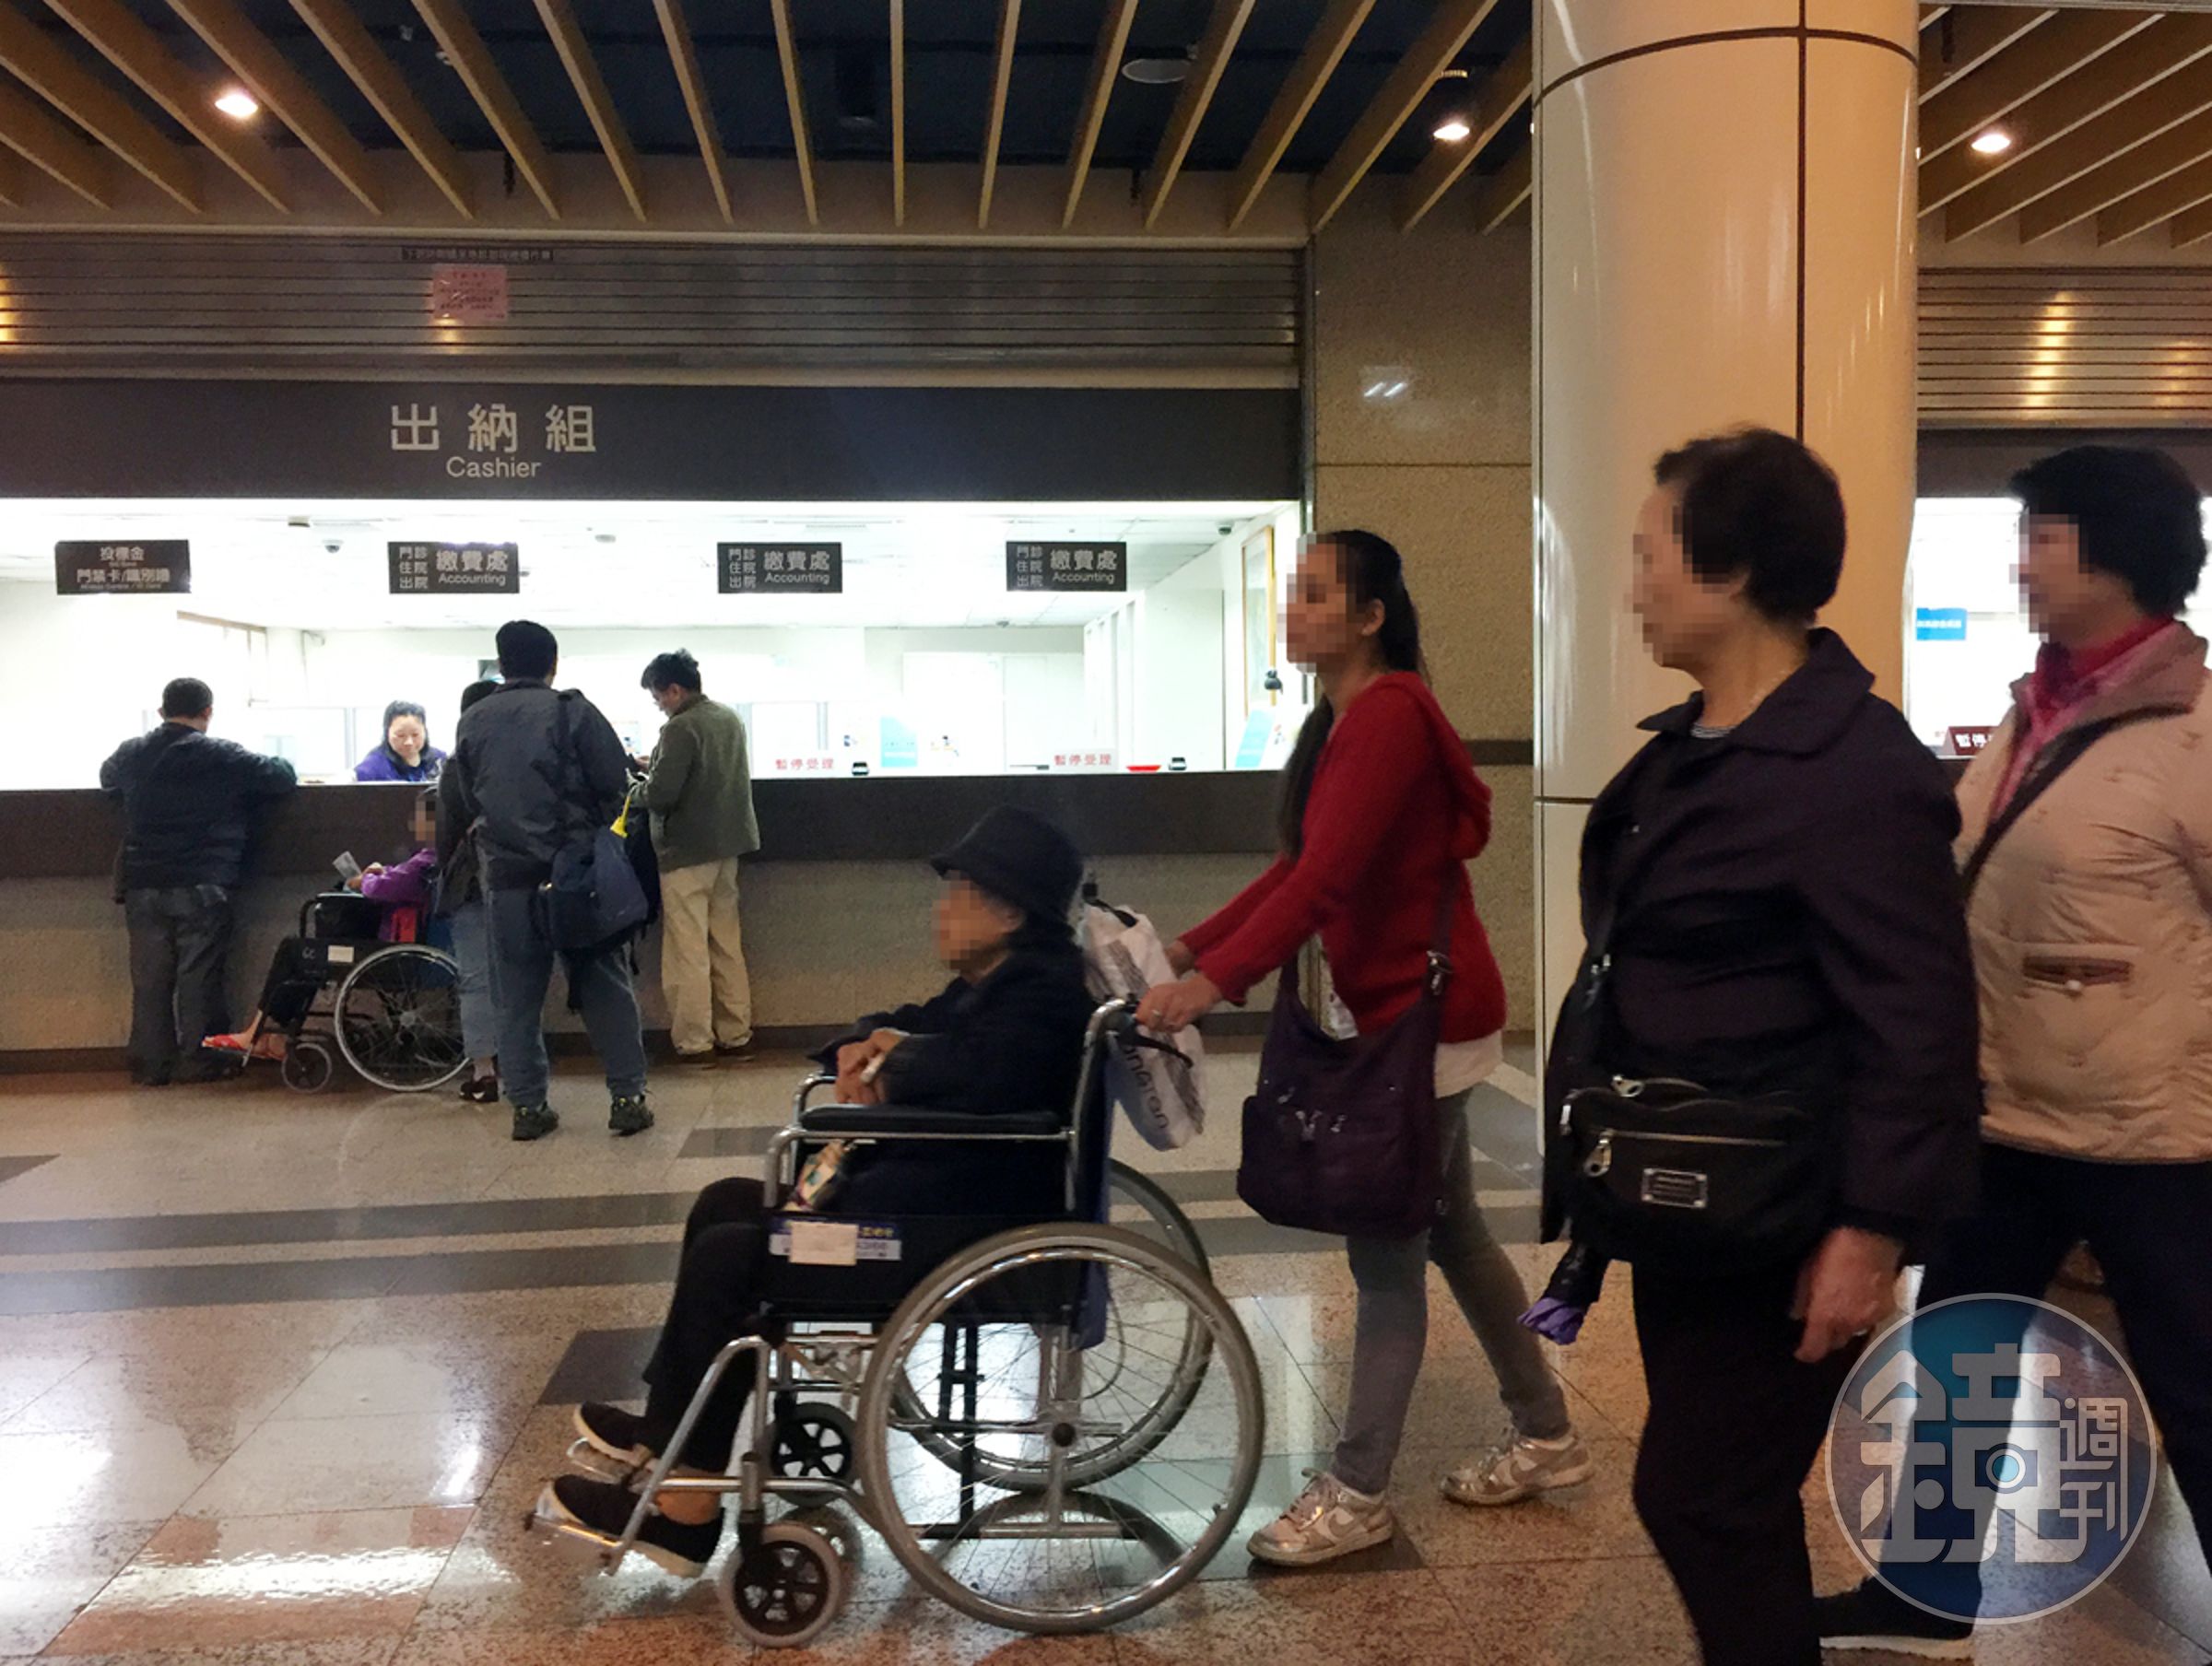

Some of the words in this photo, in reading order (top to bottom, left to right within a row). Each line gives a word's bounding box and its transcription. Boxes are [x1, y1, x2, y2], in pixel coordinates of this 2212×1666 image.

[391, 404, 596, 452] 出納組
[446, 456, 541, 477] Cashier
[438, 572, 506, 586] Accounting
[764, 572, 830, 585] Accounting
[1052, 572, 1114, 584] Accounting
